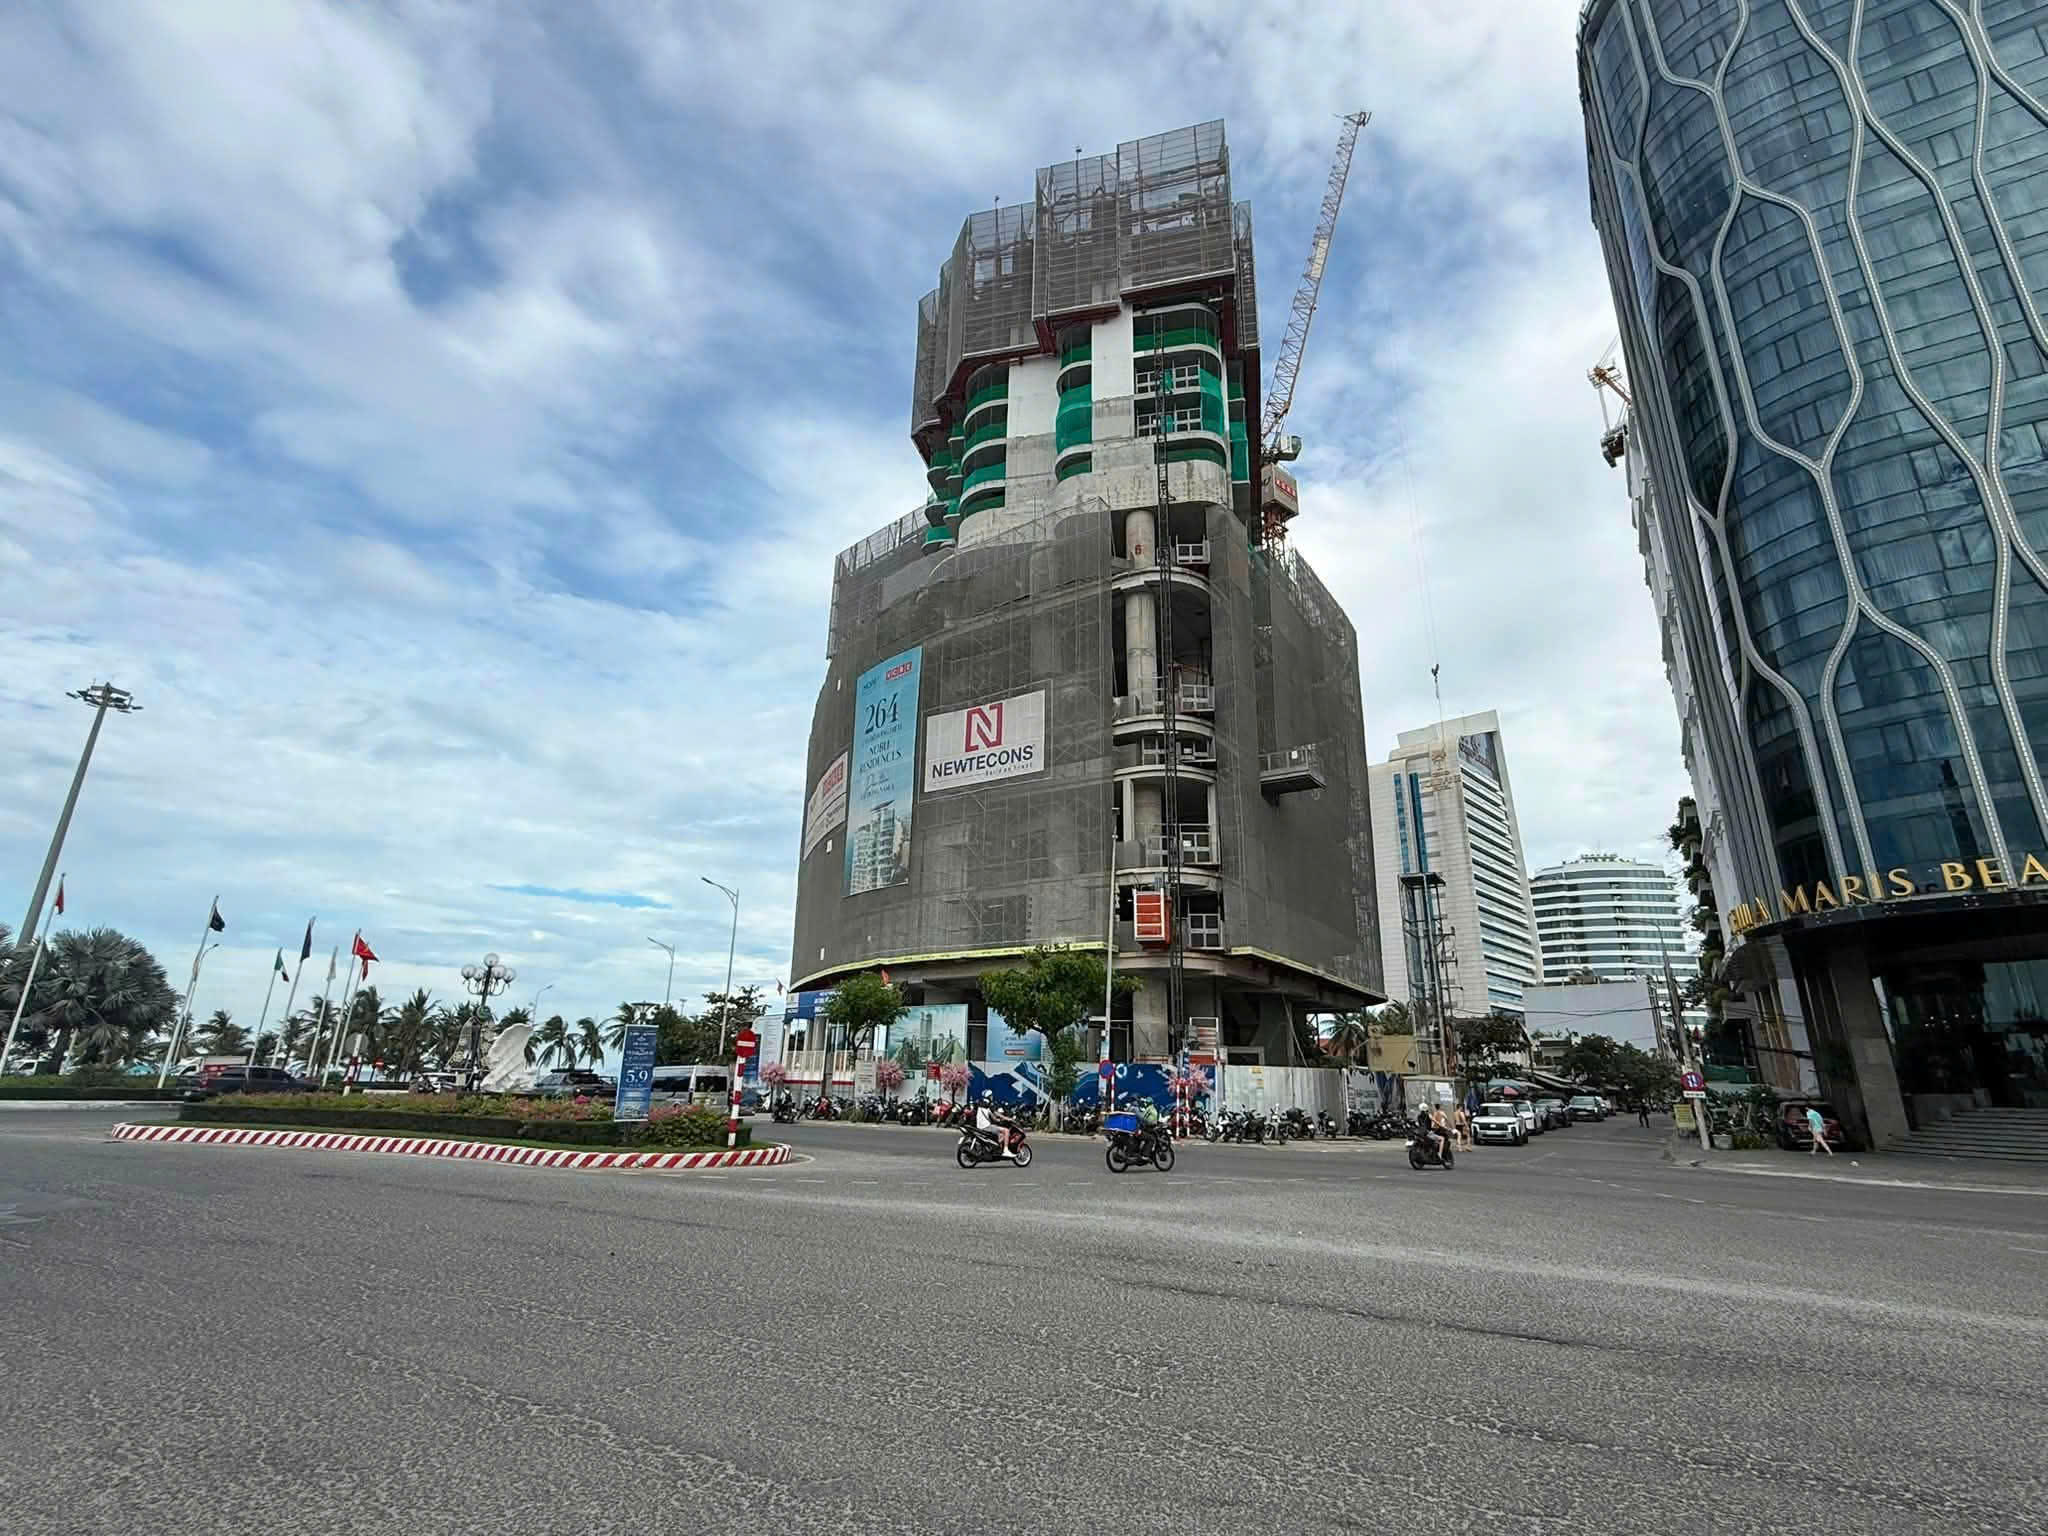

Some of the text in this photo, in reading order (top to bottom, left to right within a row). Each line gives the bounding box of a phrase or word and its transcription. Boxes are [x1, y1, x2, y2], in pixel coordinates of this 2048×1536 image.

[864, 692, 899, 733] 264
[931, 745, 1034, 779] NEWTECONS
[1781, 868, 1914, 919] MARIS
[1940, 853, 2048, 891] BEA
